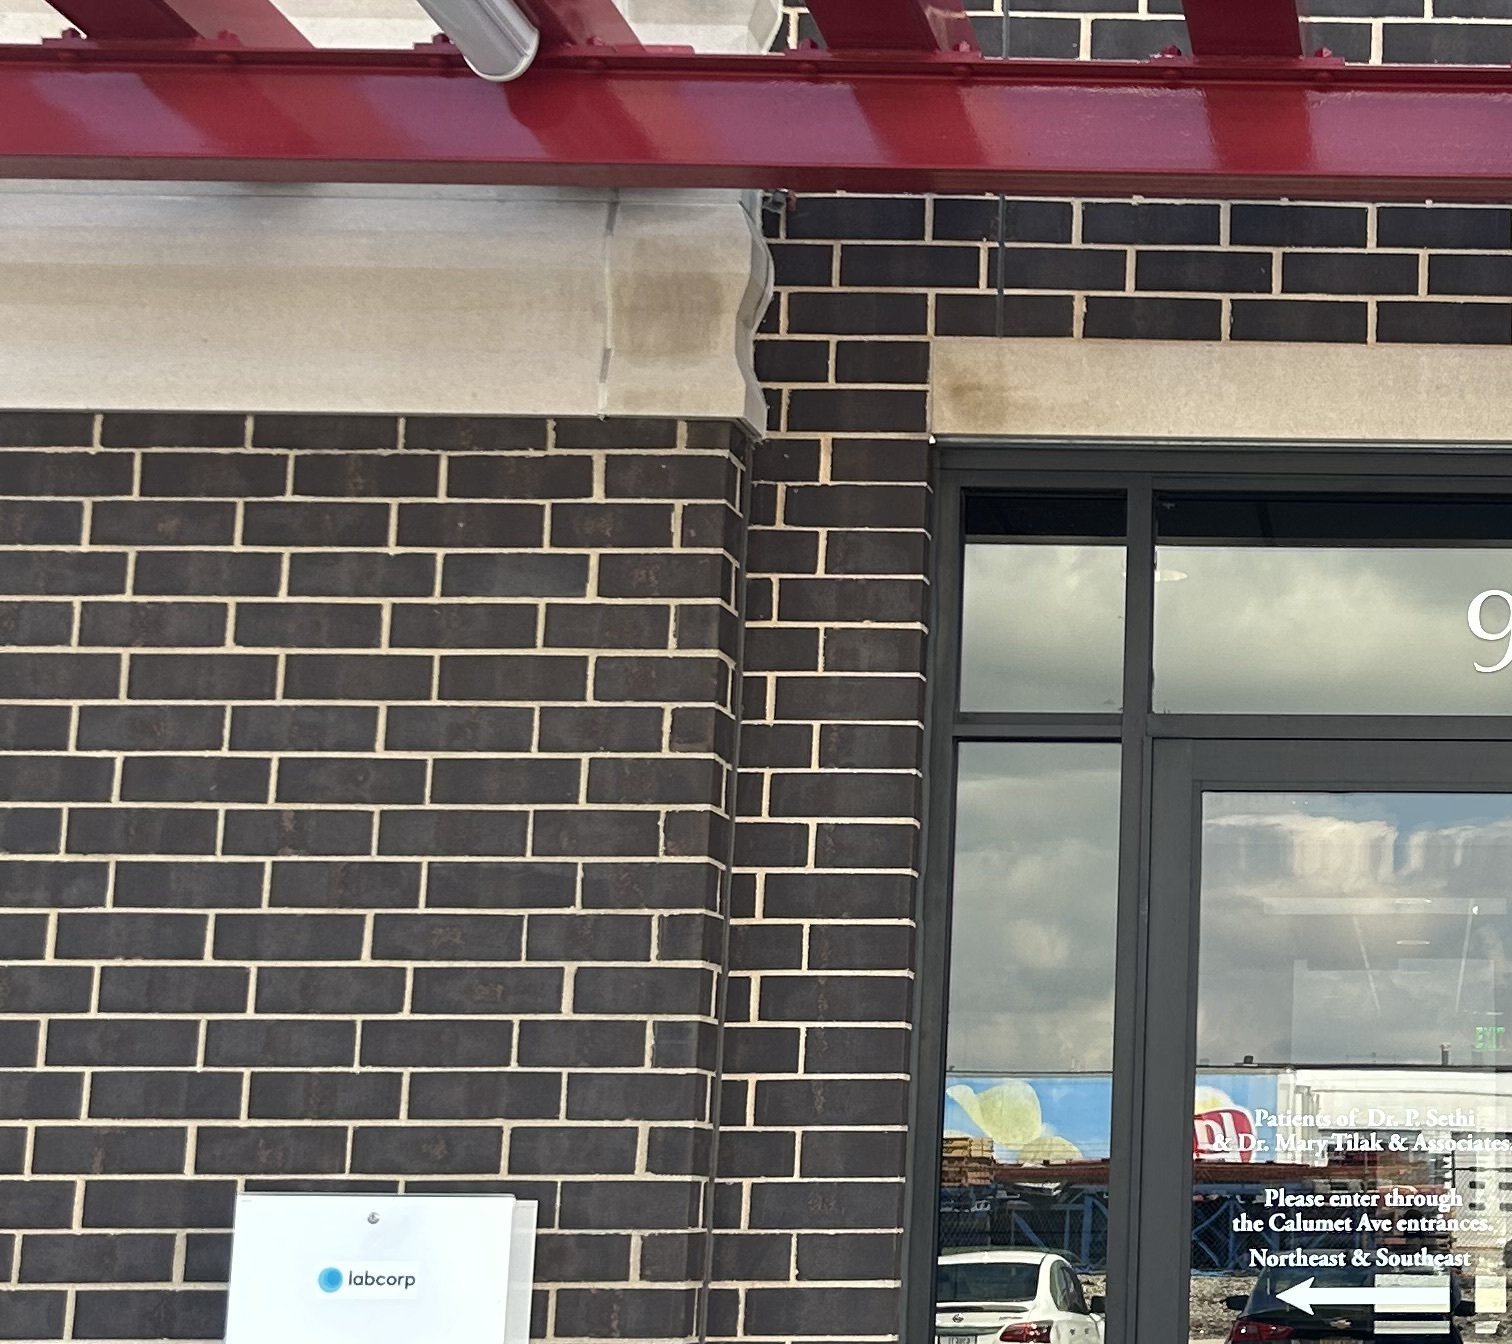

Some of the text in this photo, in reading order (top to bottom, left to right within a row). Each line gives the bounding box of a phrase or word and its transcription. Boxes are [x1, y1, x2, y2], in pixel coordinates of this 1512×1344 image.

[1254, 1107, 1476, 1127] Patients of Dr. P. Sethi
[1212, 1133, 1232, 1152] &
[1238, 1133, 1270, 1152] Dr.
[1275, 1132, 1328, 1157] Mary
[1331, 1132, 1384, 1152] Tilak
[1388, 1133, 1408, 1152] &
[1264, 1188, 1463, 1213] Please enter through
[1232, 1212, 1494, 1232] the Calumet Ave entrances.
[1248, 1247, 1472, 1267] Northeast & Southeast
[348, 1270, 416, 1289] labcorp
